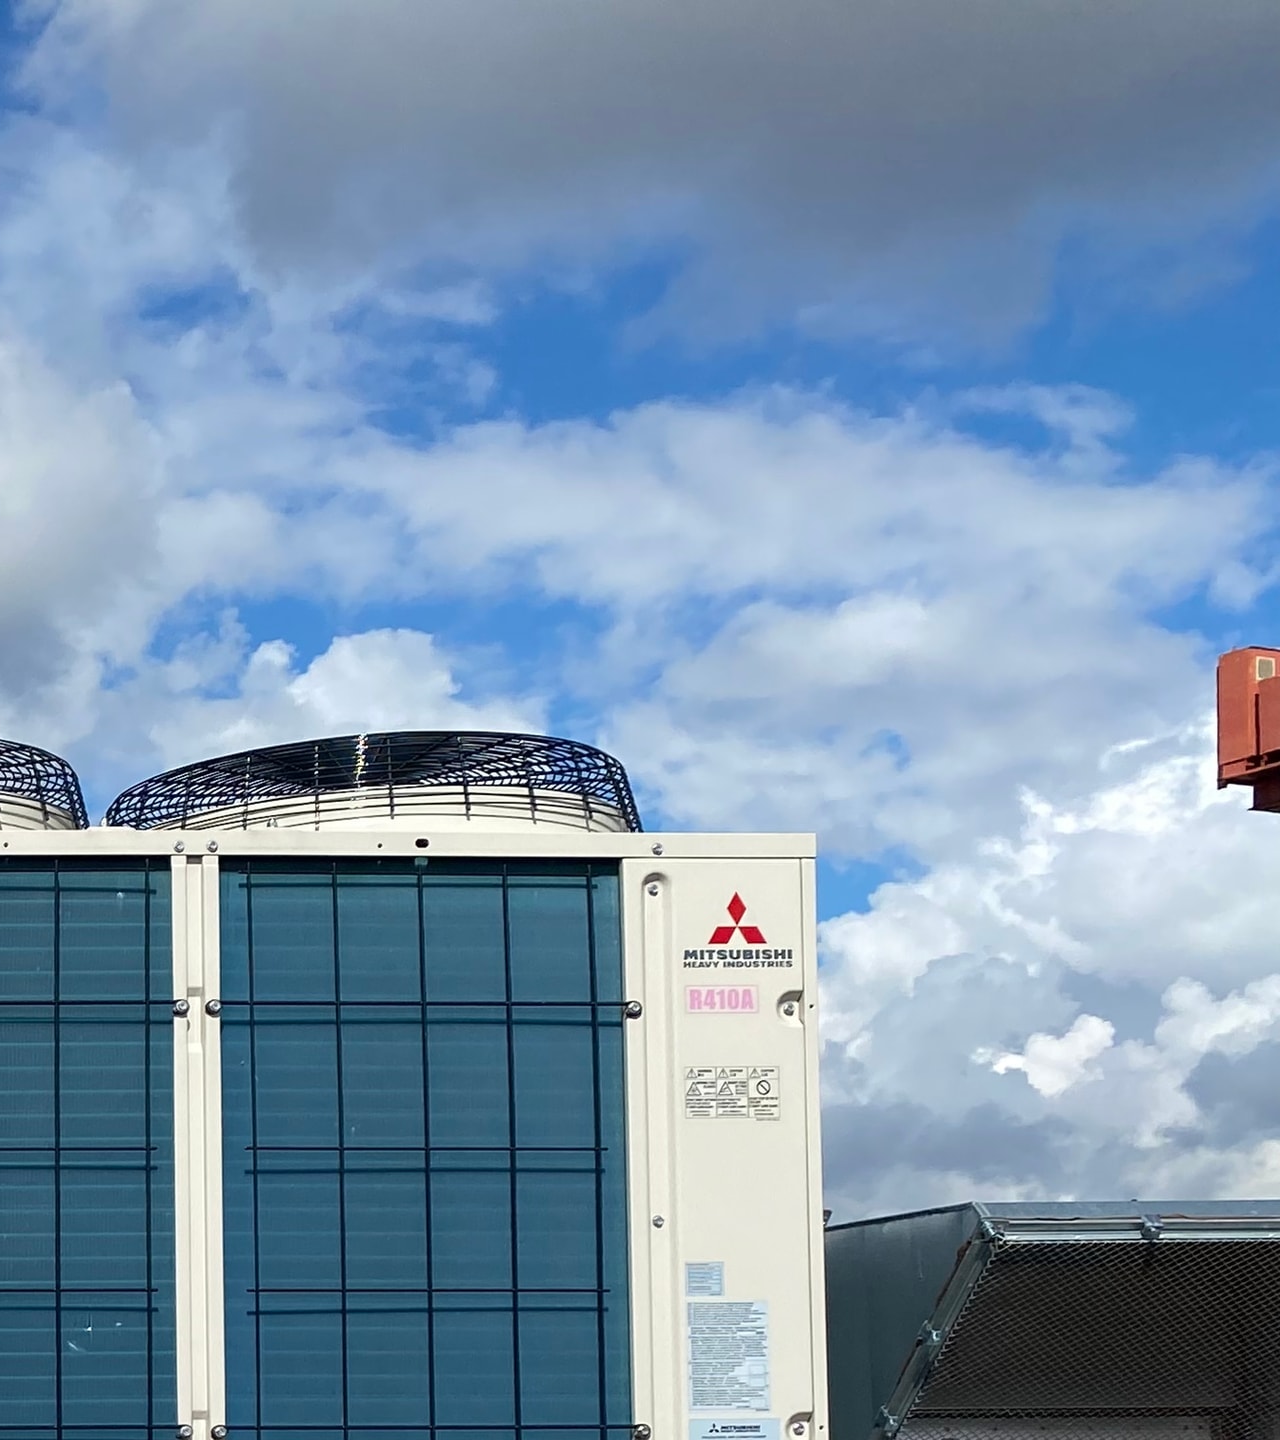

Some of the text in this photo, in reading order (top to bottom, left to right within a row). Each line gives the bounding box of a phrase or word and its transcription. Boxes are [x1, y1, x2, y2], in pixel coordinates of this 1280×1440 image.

[683, 949, 793, 960] MITSUBISHI
[723, 960, 793, 968] INDUSTRIES
[689, 989, 754, 1010] R410A
